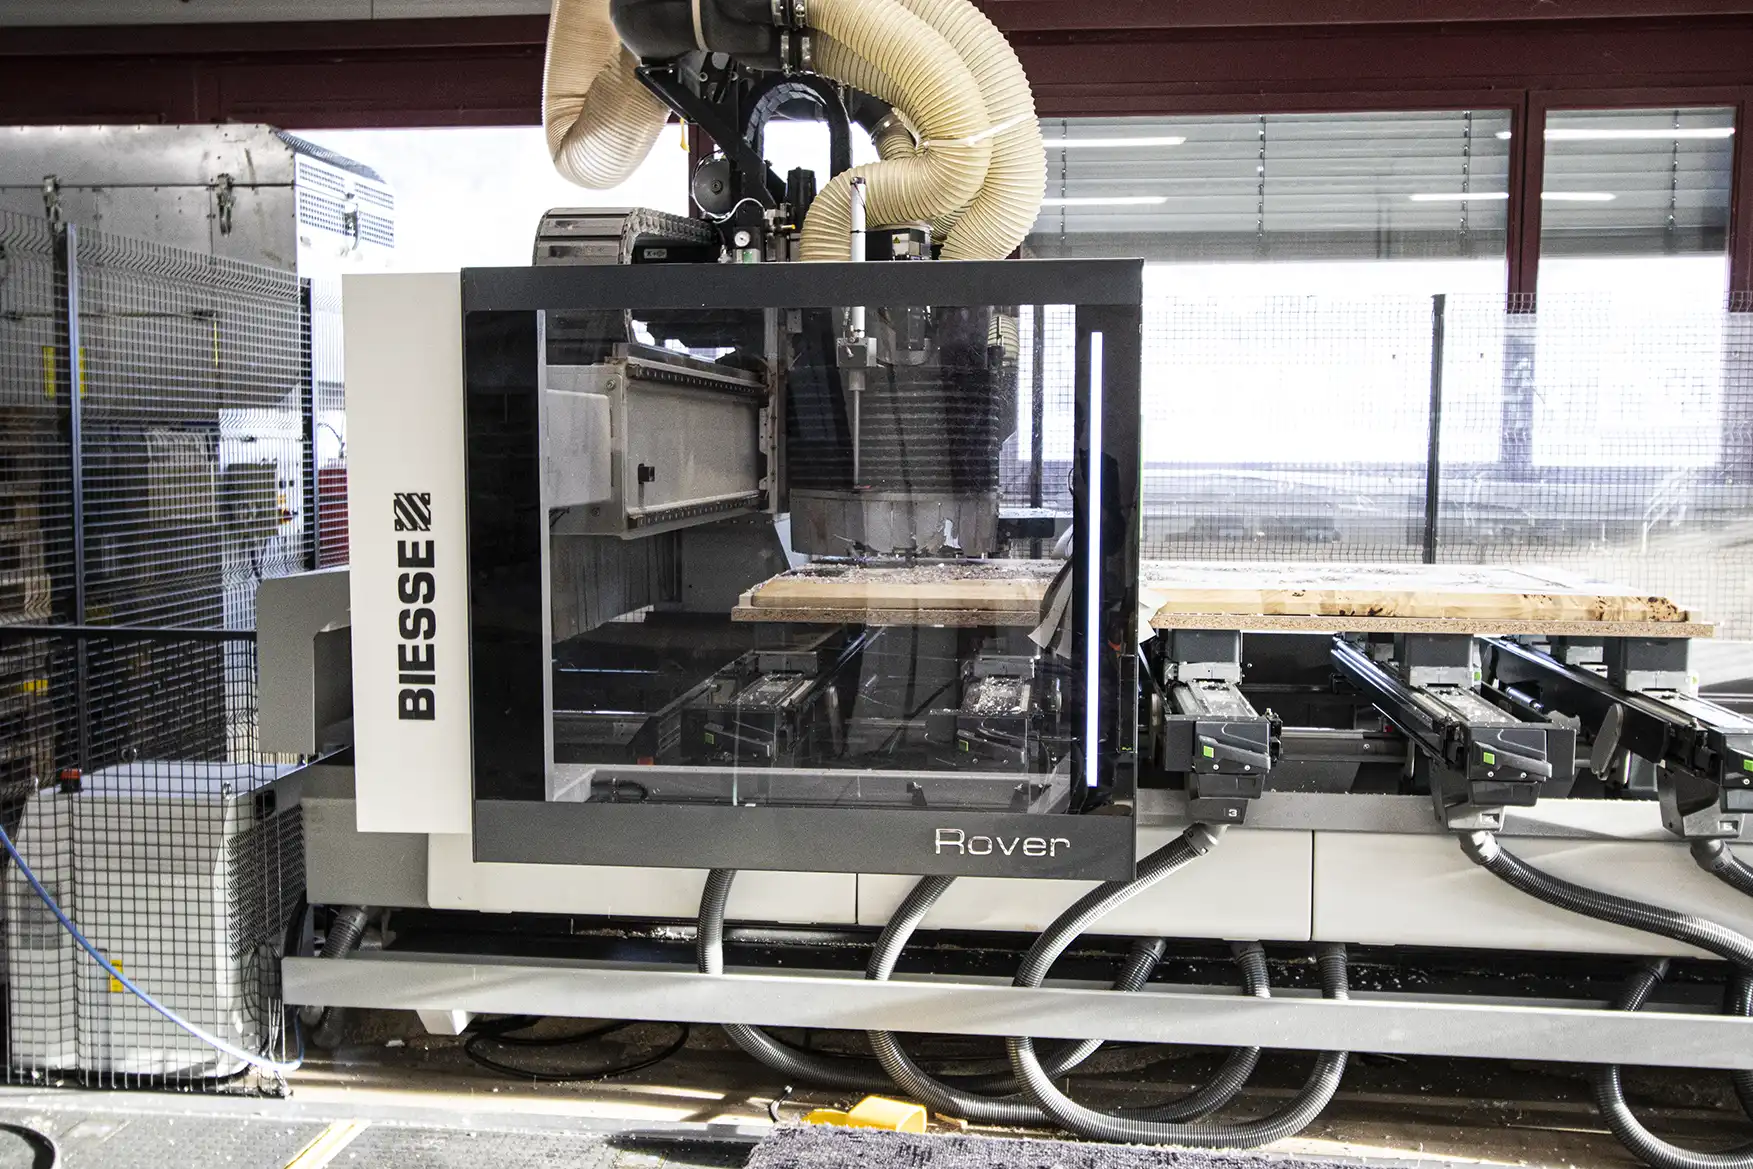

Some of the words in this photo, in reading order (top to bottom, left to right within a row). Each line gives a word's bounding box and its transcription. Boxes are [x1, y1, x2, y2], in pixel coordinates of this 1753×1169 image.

[397, 540, 437, 721] BIESSE
[1228, 808, 1238, 817] 3
[935, 828, 1071, 857] Rover
